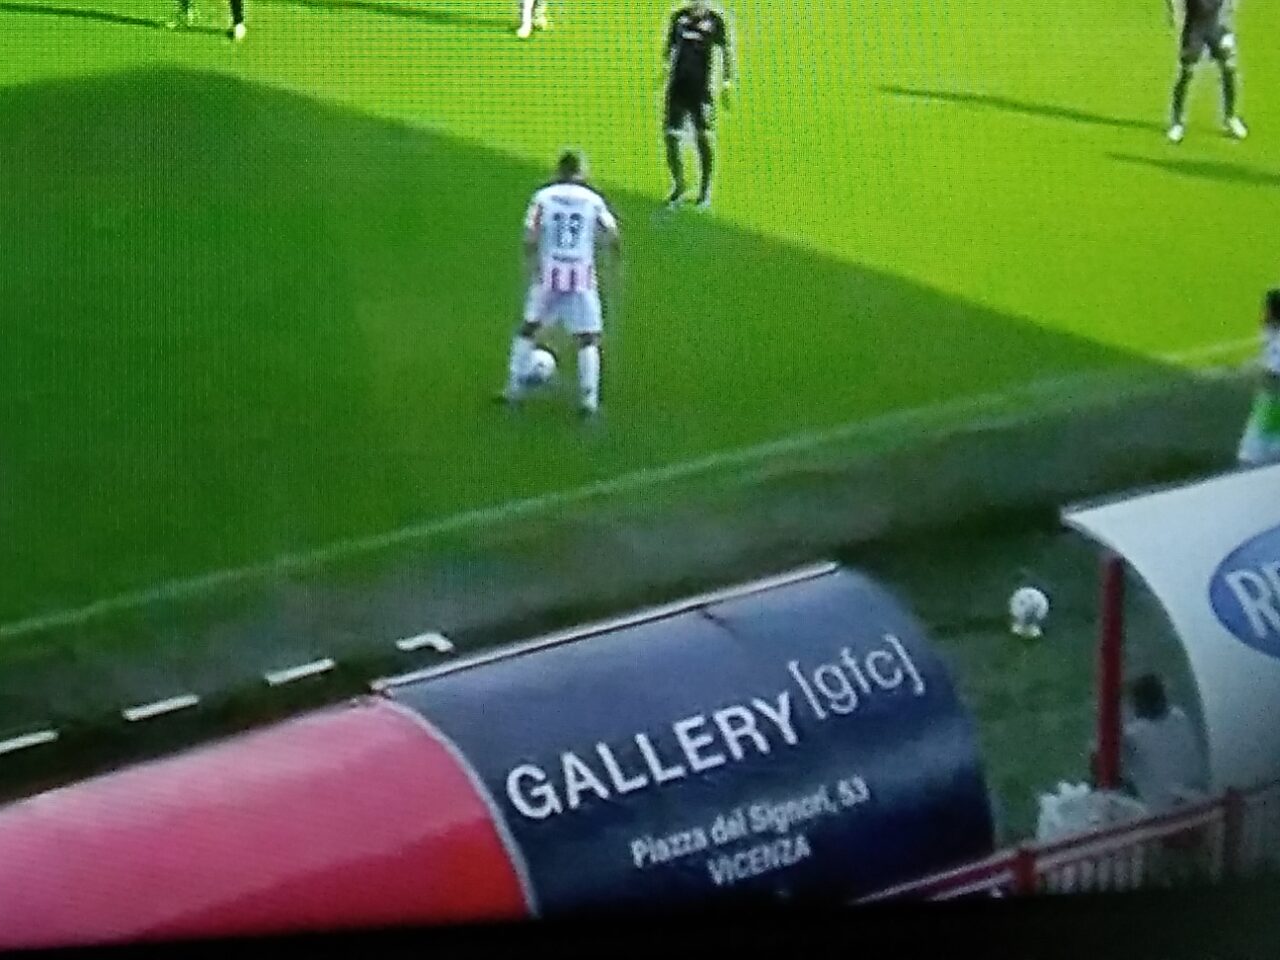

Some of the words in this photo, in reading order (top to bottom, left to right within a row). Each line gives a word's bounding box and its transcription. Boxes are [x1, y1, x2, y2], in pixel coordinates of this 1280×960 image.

[506, 691, 798, 819] GALLERY
[787, 633, 926, 720] [gfc]
[708, 835, 812, 885] VICENZA
